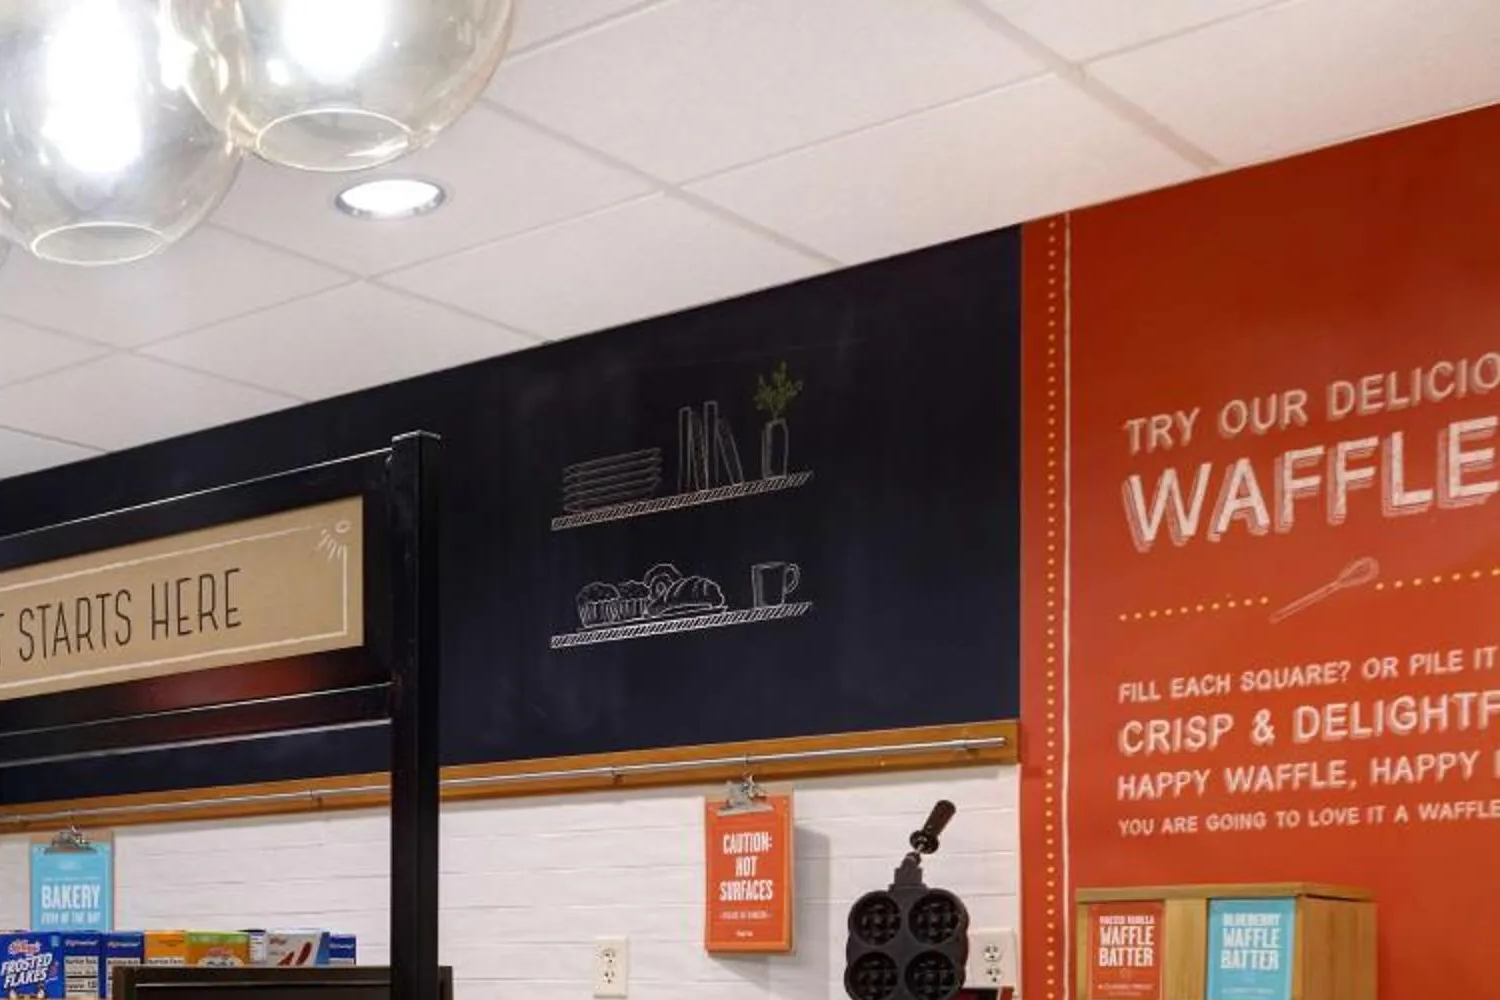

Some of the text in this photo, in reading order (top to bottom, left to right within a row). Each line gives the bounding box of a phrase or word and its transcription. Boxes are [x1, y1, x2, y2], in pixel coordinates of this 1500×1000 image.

[1123, 407, 1200, 455] TRY
[1218, 389, 1308, 438] OUR
[1122, 416, 1500, 553] WAFFLE
[18, 589, 131, 663] STARTS
[149, 568, 241, 640] HERE
[1119, 646, 1497, 703] FILL EACH SQUARE? OR PILE IT
[1119, 713, 1234, 756] CRISP
[1251, 709, 1274, 744] &
[1117, 769, 1211, 800] HAPPY
[1225, 759, 1357, 793] WAFFLE,
[1370, 750, 1481, 785] HAPPY
[1119, 818, 1154, 836] YOU
[1161, 815, 1198, 834] ARE
[1206, 812, 1266, 831] GOING
[1276, 810, 1300, 828] TO
[1309, 807, 1360, 827] LOVE
[1368, 805, 1386, 823] IT
[1395, 804, 1408, 823] A
[41, 884, 100, 909] BAKERY
[719, 879, 773, 901] SURFACES
[1100, 925, 1155, 945] WAFFLE
[1223, 927, 1281, 948] WAFFLE
[1, 953, 52, 976] FROSTED
[1099, 947, 1153, 966] BATTER
[1220, 949, 1278, 969] BATTER
[4, 969, 47, 989] FLAKES
